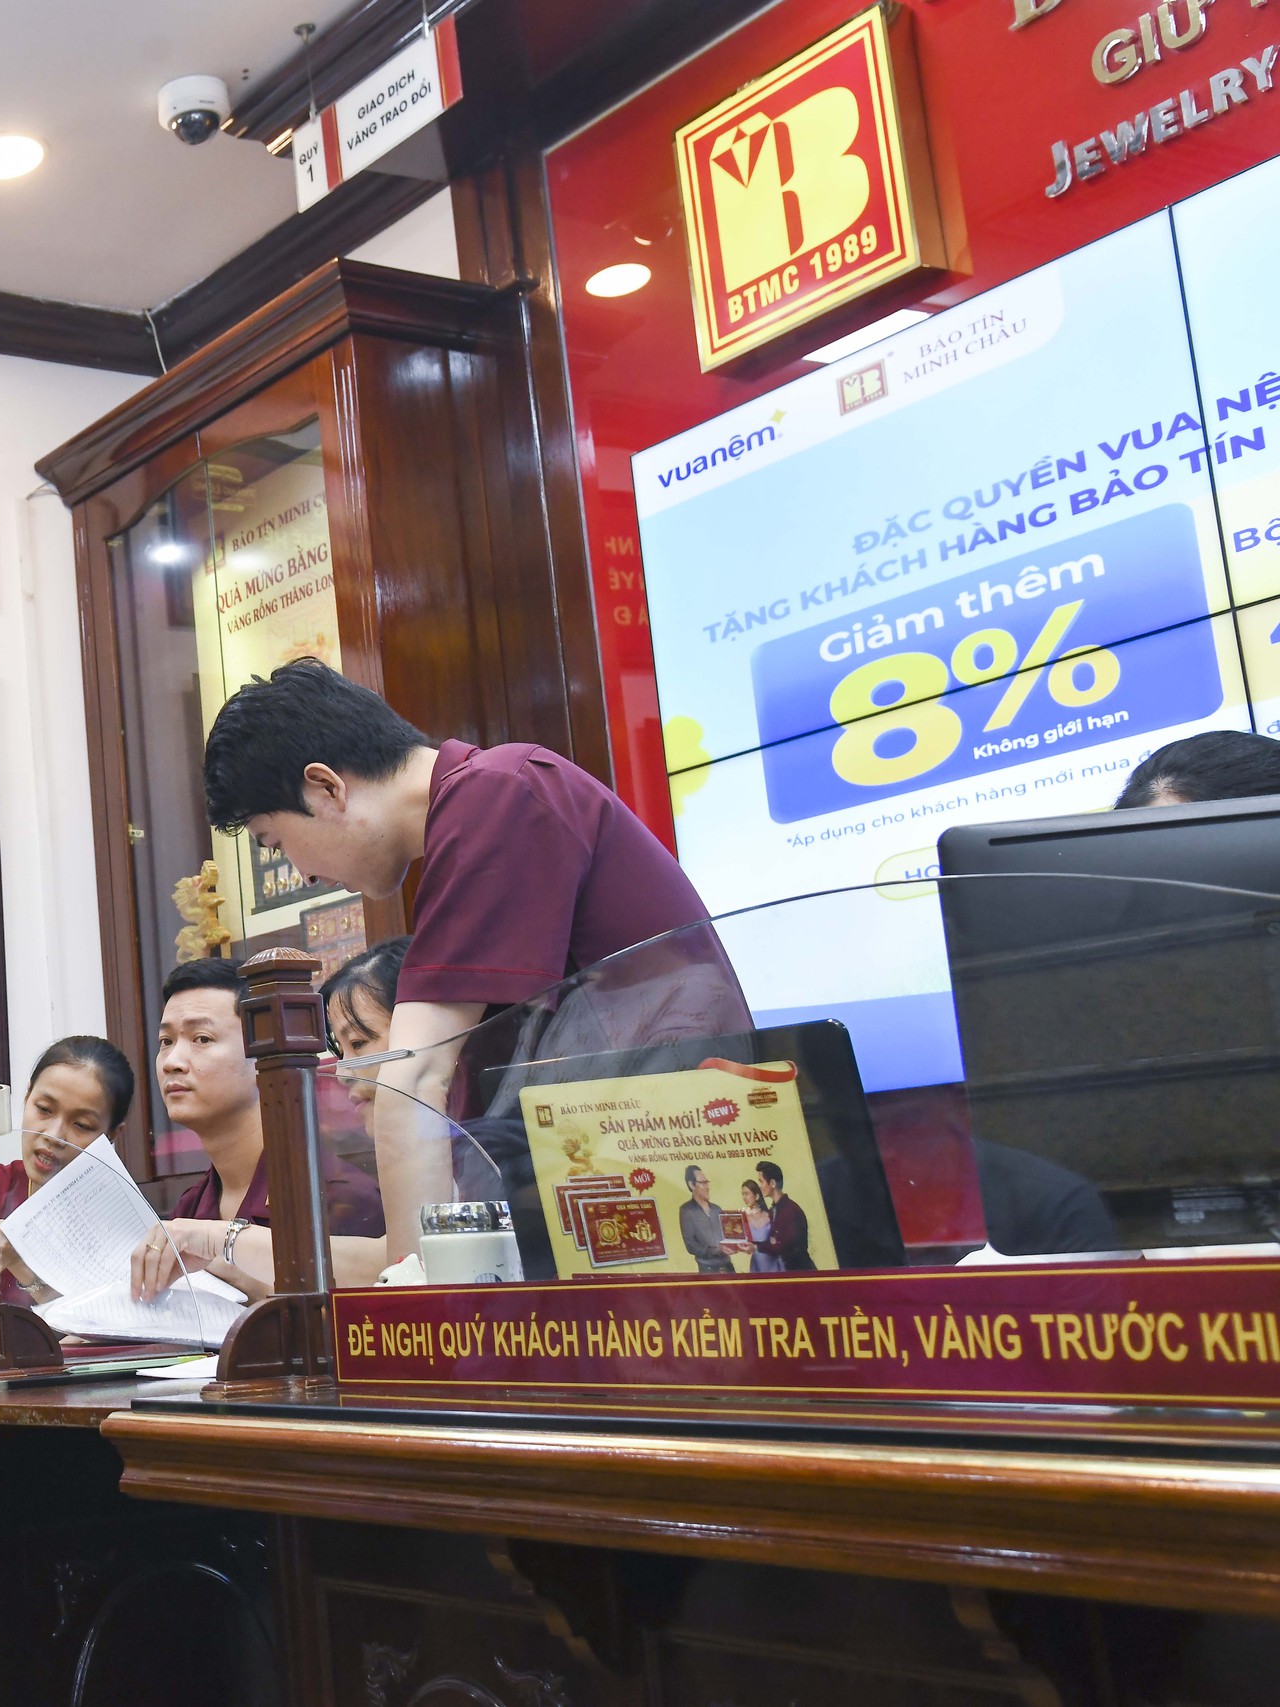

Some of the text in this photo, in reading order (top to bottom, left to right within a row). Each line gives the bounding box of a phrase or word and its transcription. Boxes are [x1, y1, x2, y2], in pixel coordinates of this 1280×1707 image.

[347, 78, 432, 151] VÀNG TRAO ĐỔI
[357, 69, 416, 119] GIAO DỊCH
[1045, 44, 1280, 198] JEWELRY
[307, 164, 314, 183] 1
[727, 223, 878, 325] BTMC 1989
[903, 318, 1028, 385] MINH CHÂU
[919, 309, 1006, 358] BẢO TÍN
[657, 424, 775, 490] vuanệm
[852, 371, 1280, 555] ĐẶC QUYỀN VUA NỆ
[231, 530, 255, 552] BẢO
[257, 517, 276, 540] TÍN
[278, 500, 311, 526] MINH
[702, 597, 791, 644] TẶNG
[799, 548, 928, 612] KHÁCH
[939, 503, 1057, 562] HÀNG
[1069, 464, 1169, 516] BẢO
[1178, 426, 1266, 474] TÍN
[217, 543, 329, 614] QUÀ MỪNG BẰNG
[227, 612, 252, 635] VÀNG
[253, 598, 279, 624] RỒNG
[280, 581, 313, 611] THĂNG
[819, 553, 1105, 664] Giảm thêm
[828, 599, 1122, 788] 8%
[973, 709, 1130, 760] Không giới hạn
[820, 821, 866, 843] dụng
[872, 810, 905, 829] cho
[911, 793, 969, 819] khách
[975, 781, 1027, 804] hàng
[1034, 768, 1075, 789] mới
[1081, 756, 1131, 779] mua
[560, 1098, 641, 1115] BẢO TÍN MINH CHÂU
[600, 1115, 625, 1135] SẢN
[628, 1110, 666, 1133] PHẨM
[618, 1128, 778, 1151] QUÀ MỪNG BẰNG BẢN VỊ VÀNG
[628, 1153, 647, 1164] VÀNG
[648, 1152, 668, 1163] RỒNG
[669, 1150, 694, 1161] THĂNG
[694, 1151, 714, 1160] LONG
[716, 1150, 726, 1158] Au
[746, 1147, 772, 1158] BTMC
[348, 1300, 1280, 1367] ĐỀ NGHỊ QUÝ KHÁCH HÀNG KIỂM TRA TIỀN, VÀNG TRƯỚC KHI
